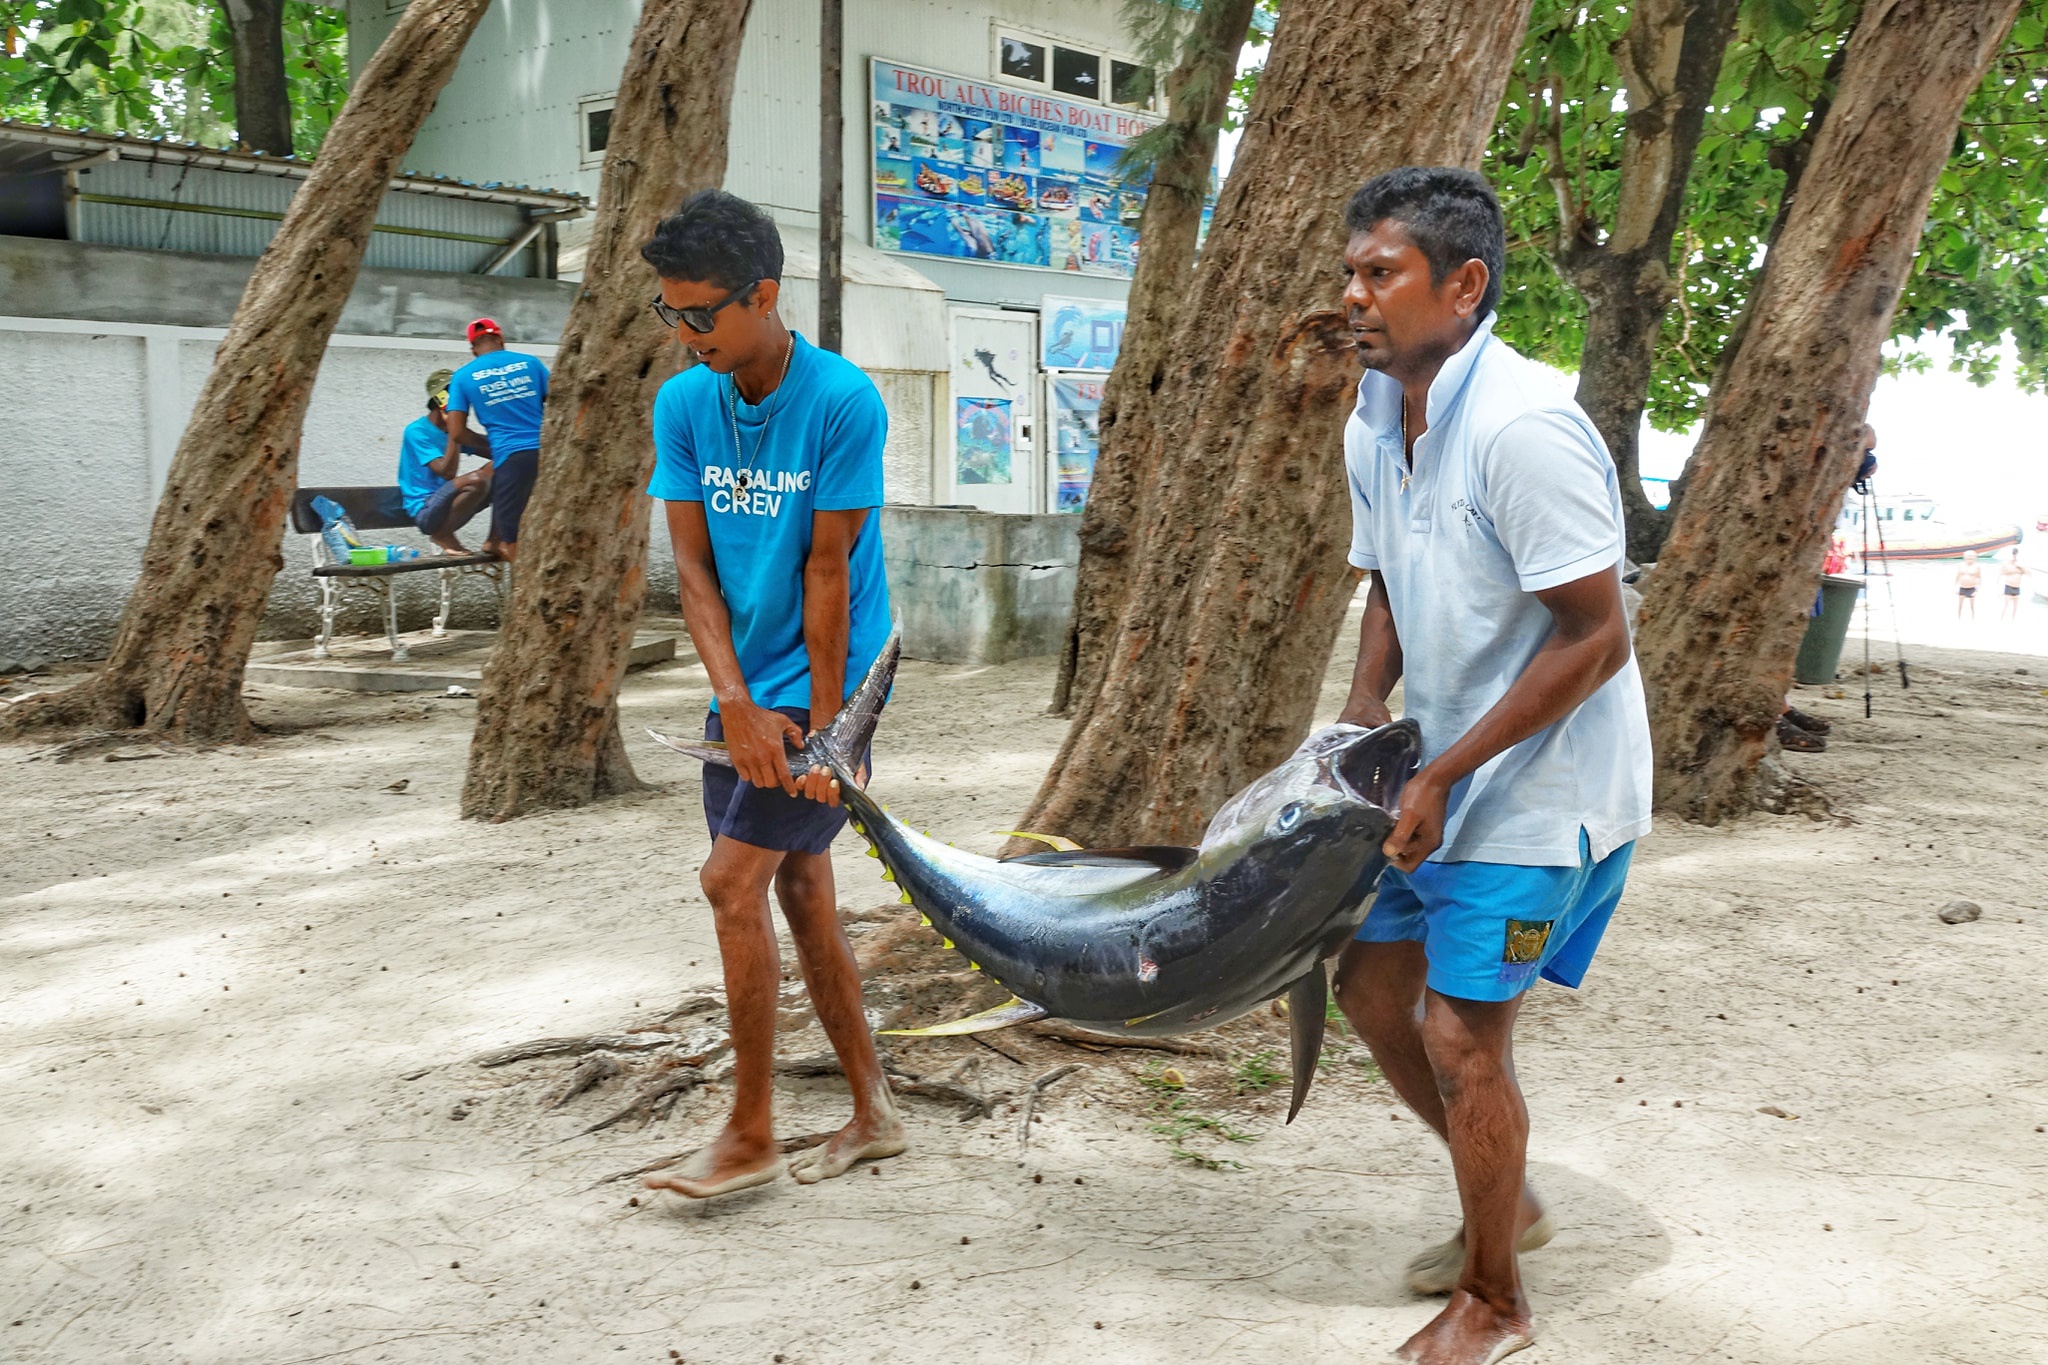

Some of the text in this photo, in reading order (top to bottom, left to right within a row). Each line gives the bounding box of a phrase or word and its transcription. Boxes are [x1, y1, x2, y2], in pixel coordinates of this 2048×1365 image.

[893, 69, 949, 99] TROU
[953, 85, 994, 108] AUX
[998, 92, 1063, 123] BICHES
[1068, 107, 1111, 132] BOAT
[472, 361, 528, 380] SEAQUEST
